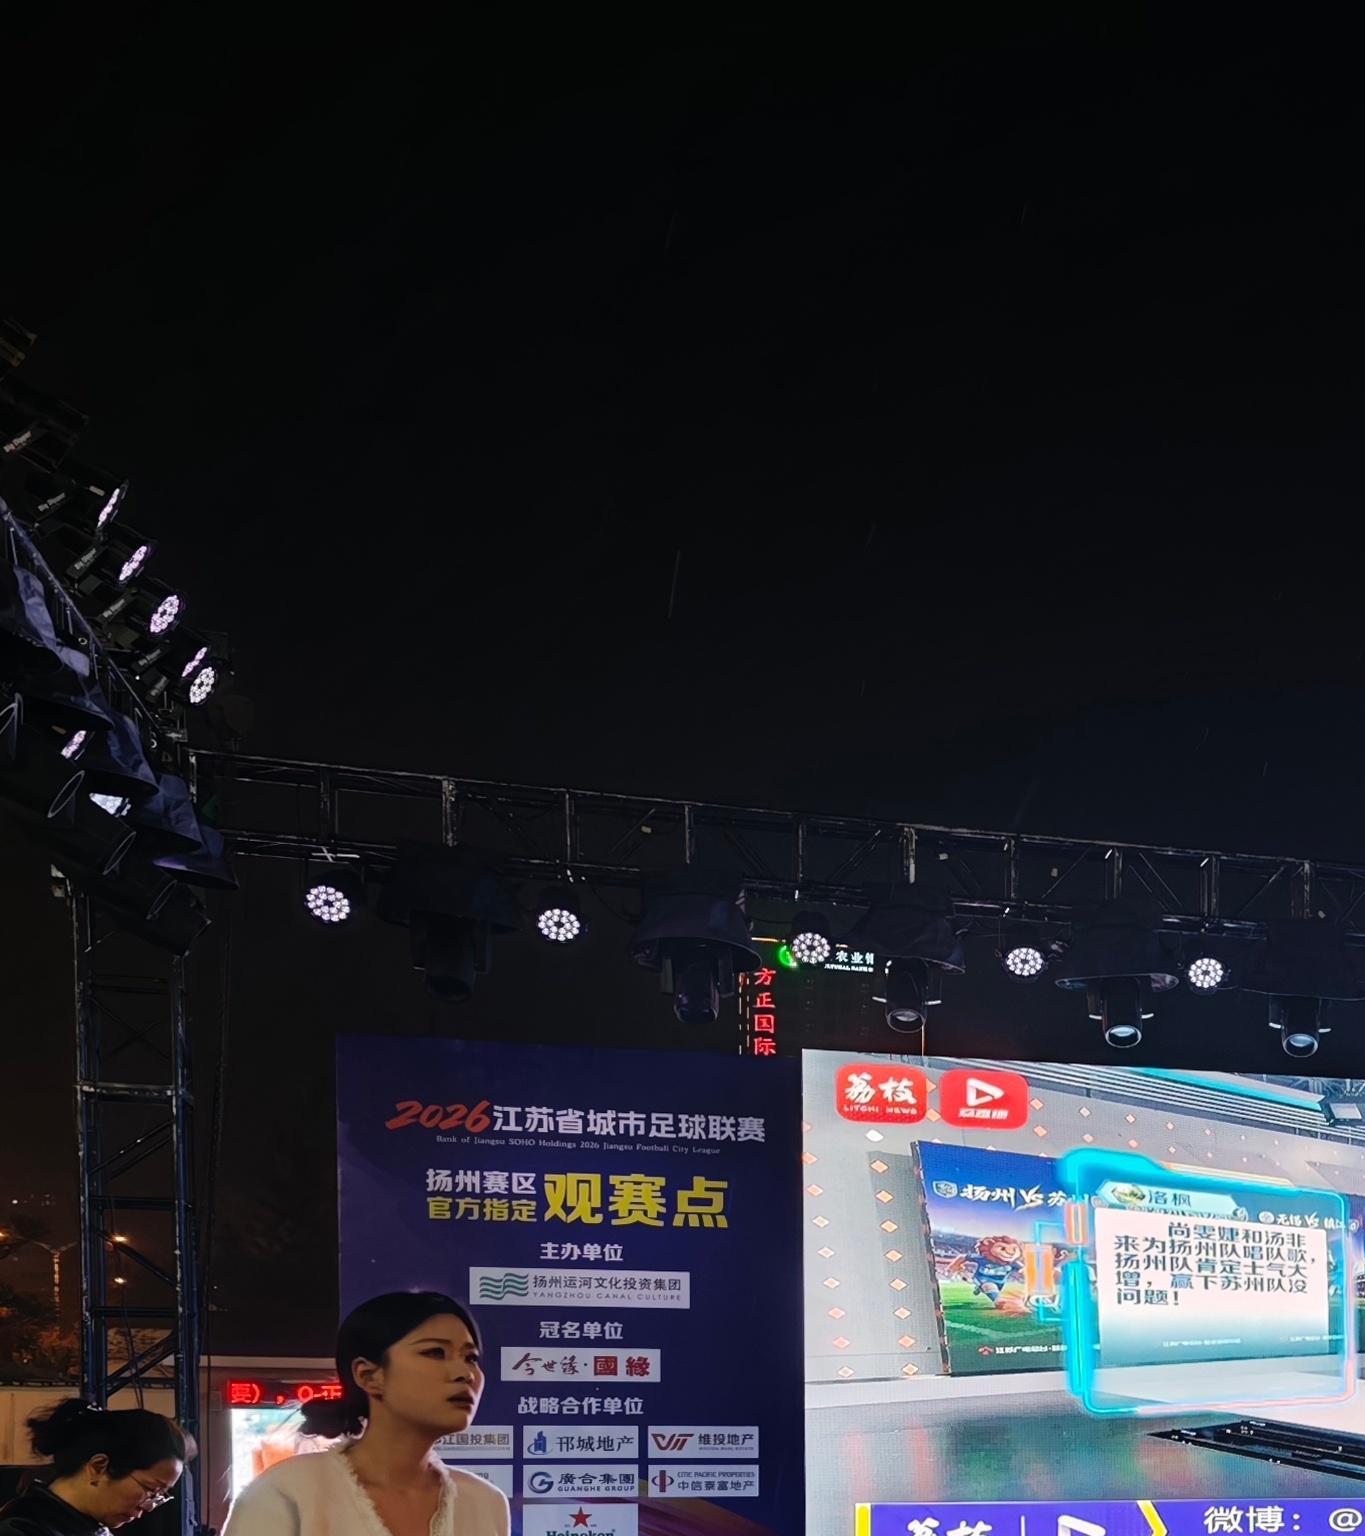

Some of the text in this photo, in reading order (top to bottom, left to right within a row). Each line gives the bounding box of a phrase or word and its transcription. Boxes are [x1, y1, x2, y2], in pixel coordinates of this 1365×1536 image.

[753, 967, 777, 1056] 方正国际
[844, 1071, 917, 1104] 荔枝
[886, 1107, 918, 1115] NEWS
[436, 1134, 457, 1143] Bank
[461, 1135, 470, 1144] of
[579, 1140, 600, 1149] 2026
[603, 1142, 633, 1151] Jiangsu
[426, 1168, 537, 1195] 扬州赛区
[543, 1172, 729, 1229] 观赛点
[959, 1184, 1016, 1209] 扬州
[426, 1196, 537, 1222] 官方指定
[540, 1241, 623, 1262] 主办单位
[1114, 1252, 1308, 1279] 扬州队肯定士气大
[532, 1275, 681, 1291] 扬州运河文化投资集团
[533, 1291, 681, 1301] YANGZHOU CANAL CULTURE
[539, 1321, 624, 1340] 冠名单位
[517, 1396, 644, 1415] 战略合作单位
[436, 1433, 510, 1446] 江国投集团
[556, 1435, 635, 1452] 邗城地产
[698, 1433, 754, 1445] 维投地产
[558, 1472, 635, 1485] 廣合集團
